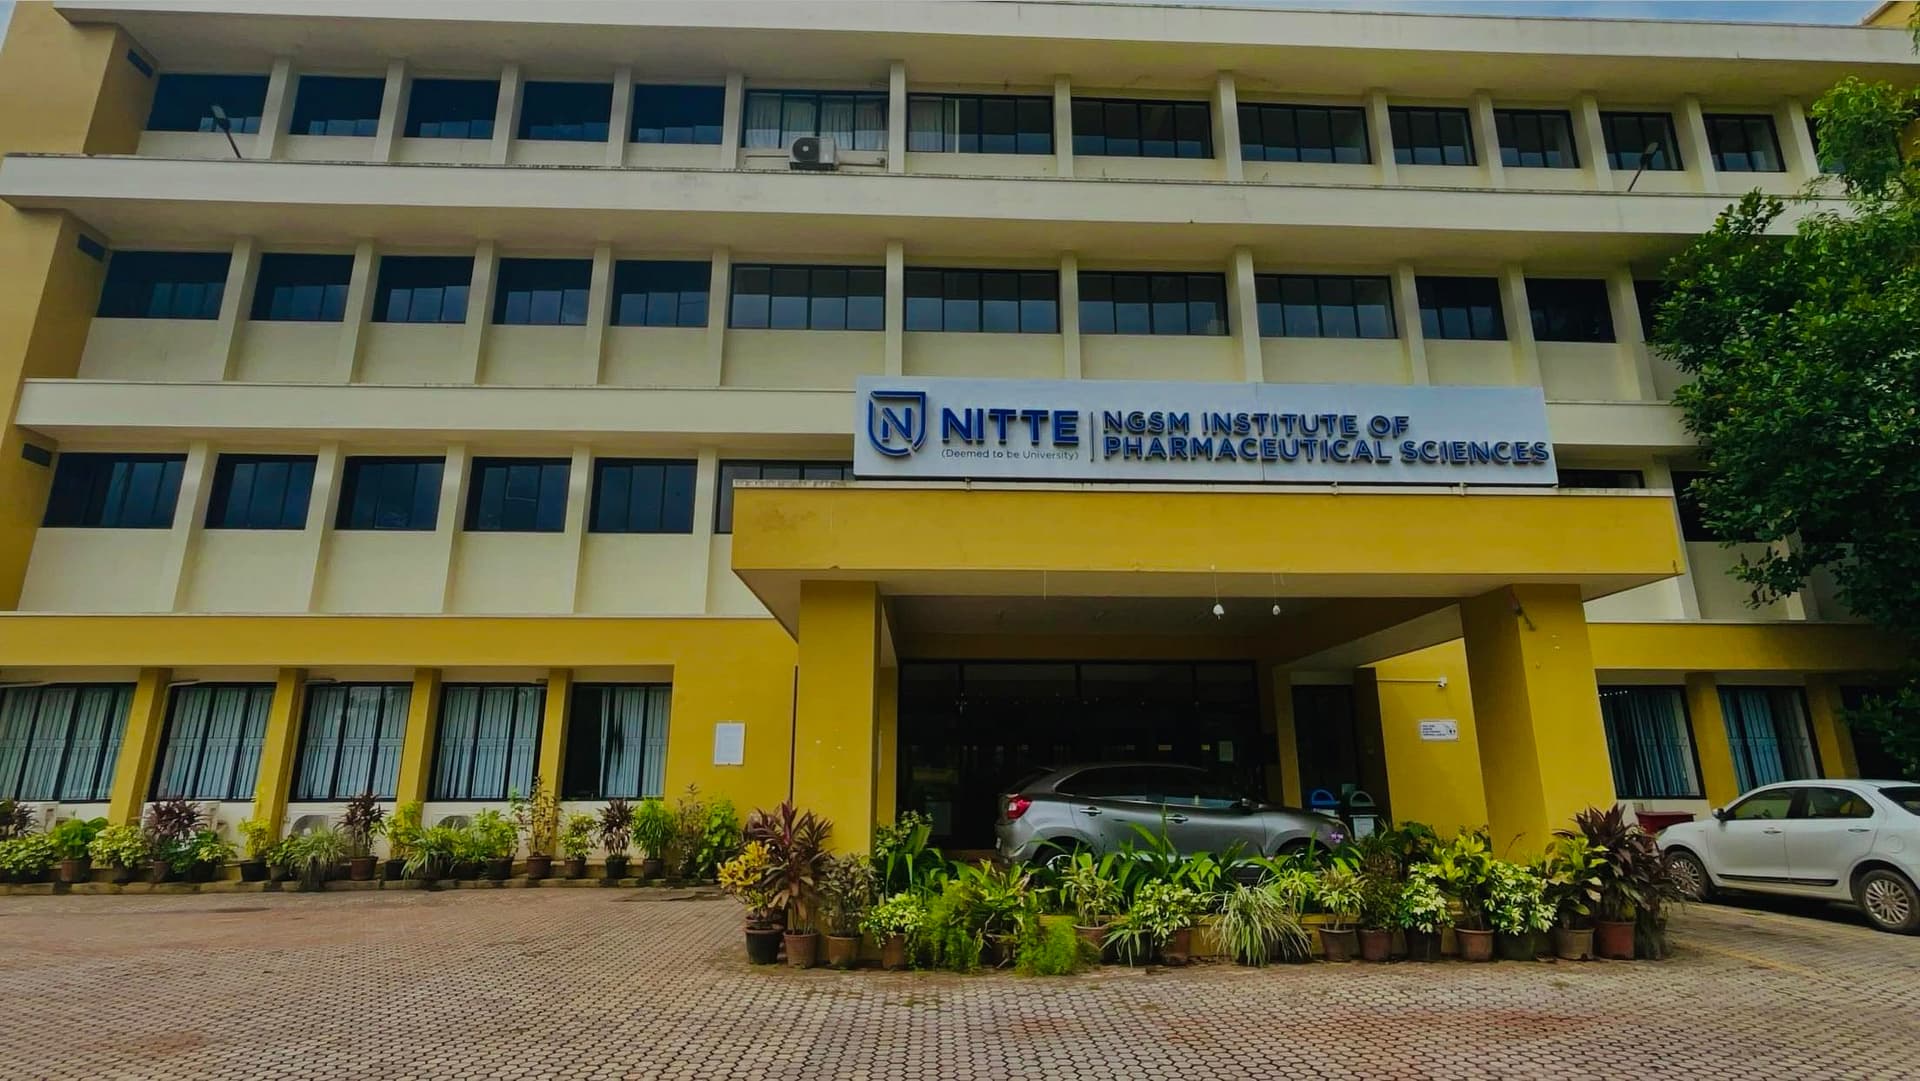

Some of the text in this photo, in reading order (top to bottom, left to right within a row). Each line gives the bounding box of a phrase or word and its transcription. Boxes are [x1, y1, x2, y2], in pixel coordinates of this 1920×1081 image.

[881, 407, 912, 441] N
[941, 408, 1079, 445] NITTE
[1104, 410, 1410, 438] NGSM INSTITUTE OF
[941, 449, 1079, 461] (Deemed to be University)
[1104, 437, 1550, 464] PHARMACEUTICAL SCIENCES
